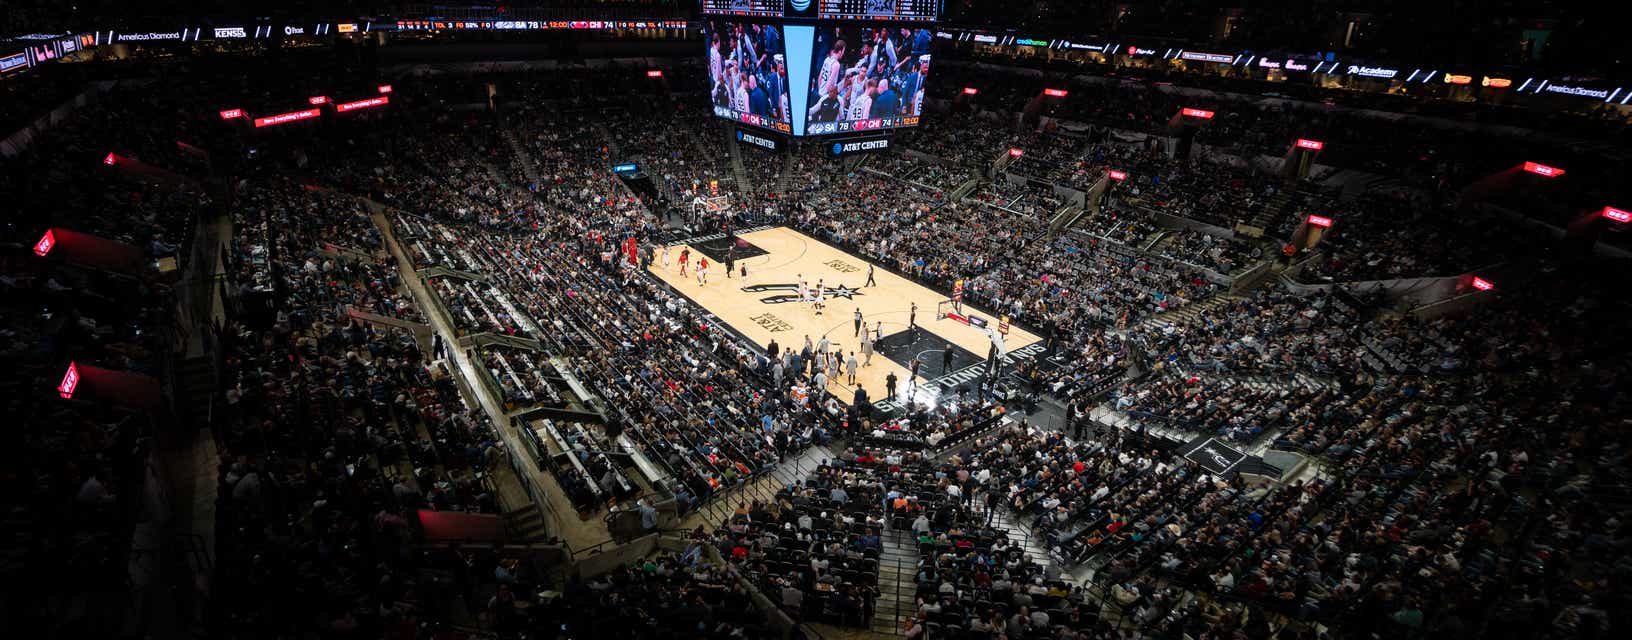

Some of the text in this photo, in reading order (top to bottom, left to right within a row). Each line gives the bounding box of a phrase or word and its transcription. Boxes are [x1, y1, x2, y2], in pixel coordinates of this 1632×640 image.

[528, 21, 539, 29] 78
[549, 21, 568, 29] 12:00
[590, 21, 602, 29] CHI
[604, 21, 614, 29] 74
[150, 32, 180, 40] Diamond
[825, 124, 835, 132] SA
[868, 121, 881, 129] CHI
[882, 119, 891, 127] 74
[755, 137, 775, 149] CENTER
[843, 140, 888, 152] AT&T CENTER
[1016, 343, 1047, 360] SAN
